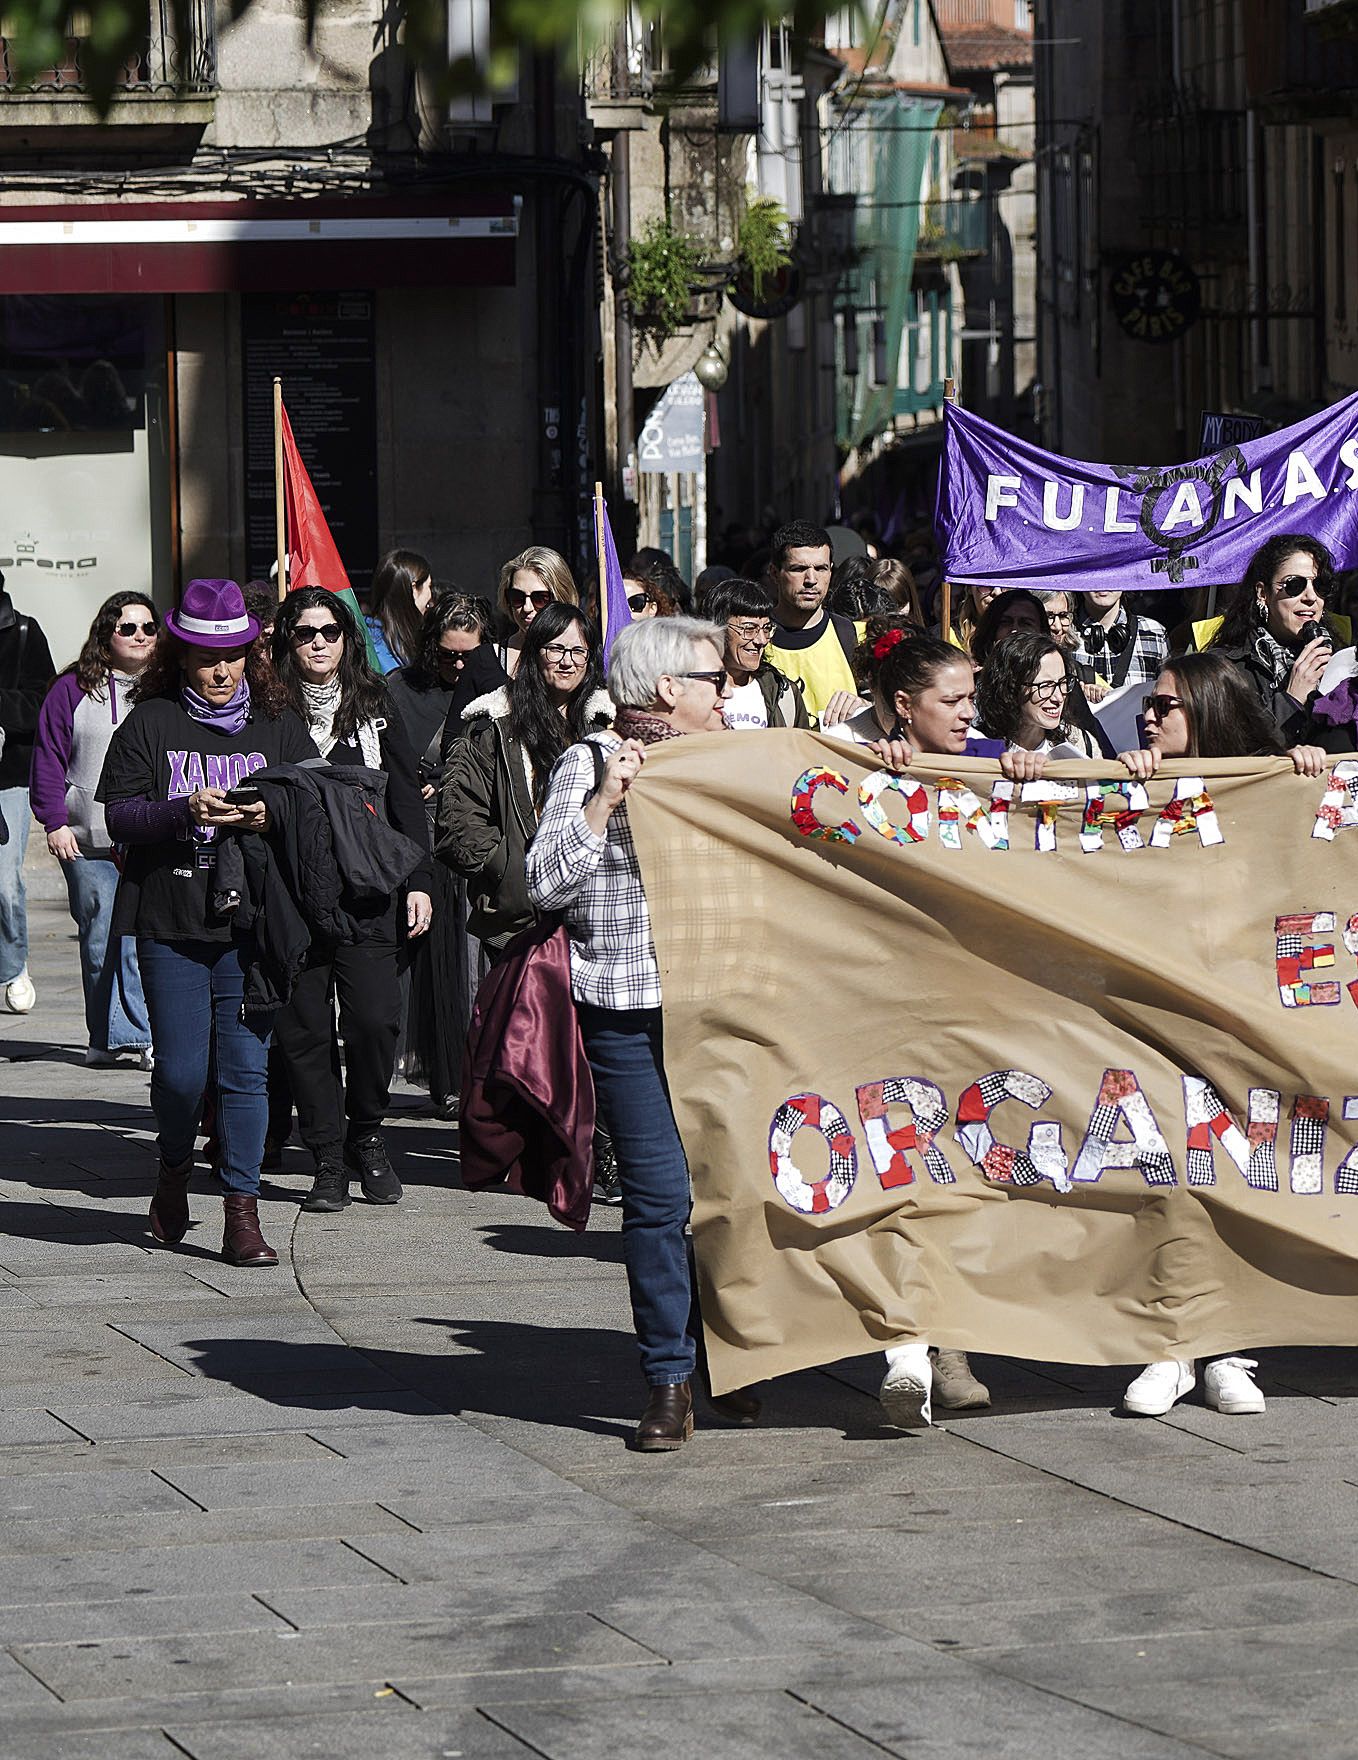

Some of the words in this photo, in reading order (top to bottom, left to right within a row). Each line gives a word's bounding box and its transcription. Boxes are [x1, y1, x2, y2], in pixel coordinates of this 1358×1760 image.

[1159, 259, 1193, 295] BAR
[1120, 306, 1185, 337] PARIS
[1203, 416, 1224, 445] MY
[789, 765, 1224, 853] CONTRA
